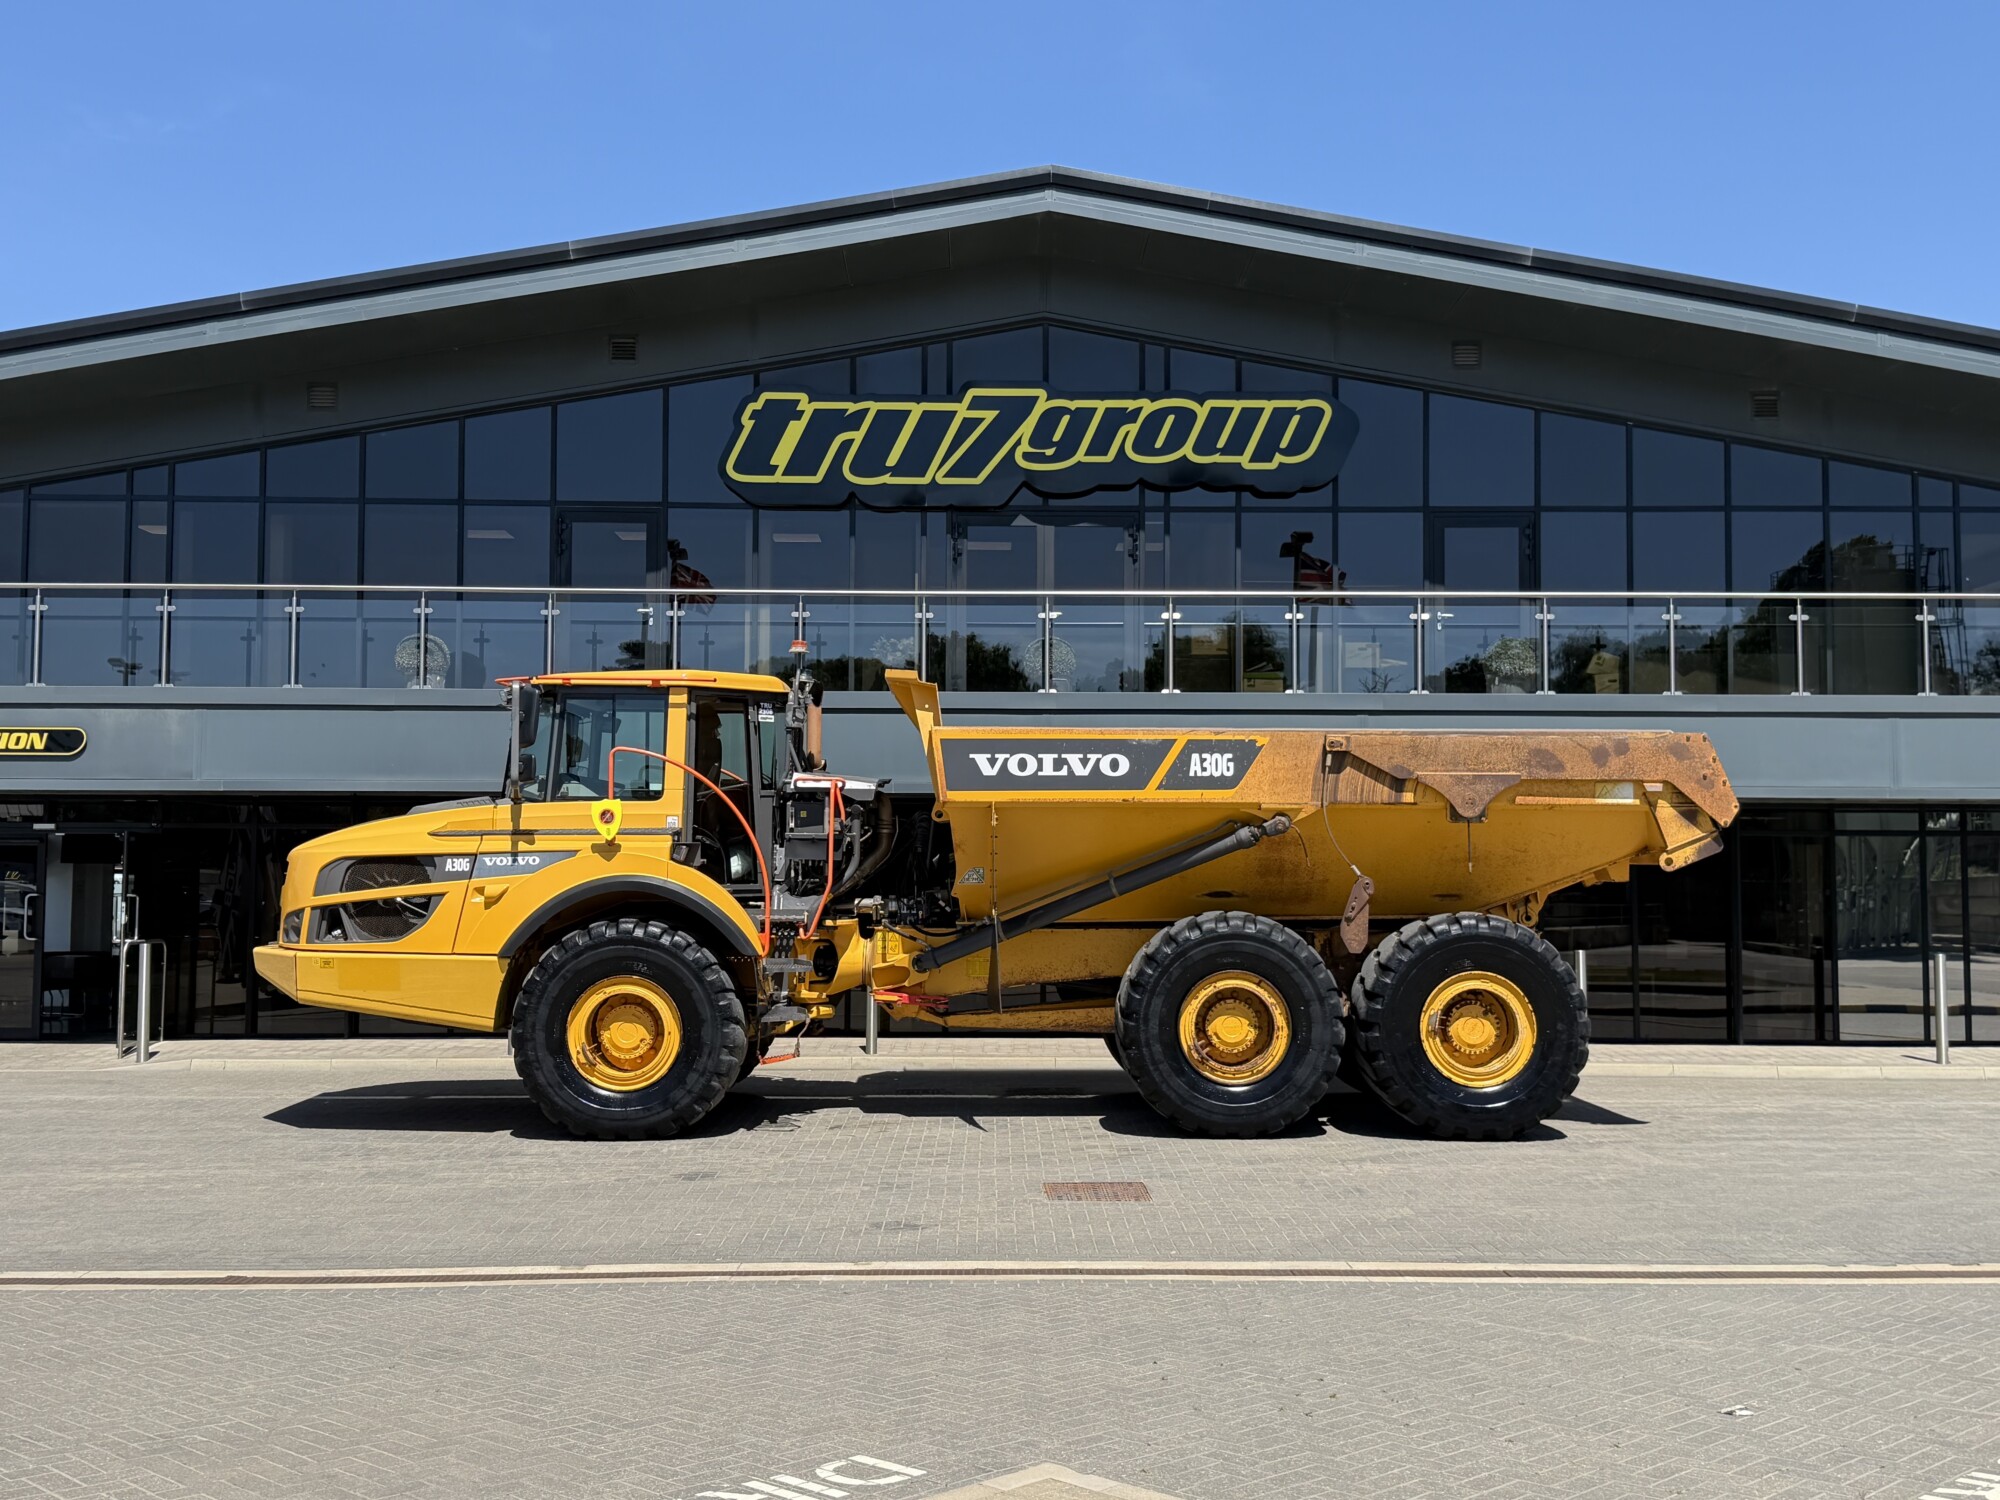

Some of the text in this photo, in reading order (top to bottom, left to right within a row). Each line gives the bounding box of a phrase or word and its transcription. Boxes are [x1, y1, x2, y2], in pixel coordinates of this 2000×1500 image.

[0, 732, 49, 750] ION
[969, 753, 1235, 777] VOLVO A30G
[445, 855, 540, 872] A30G VOLVO
